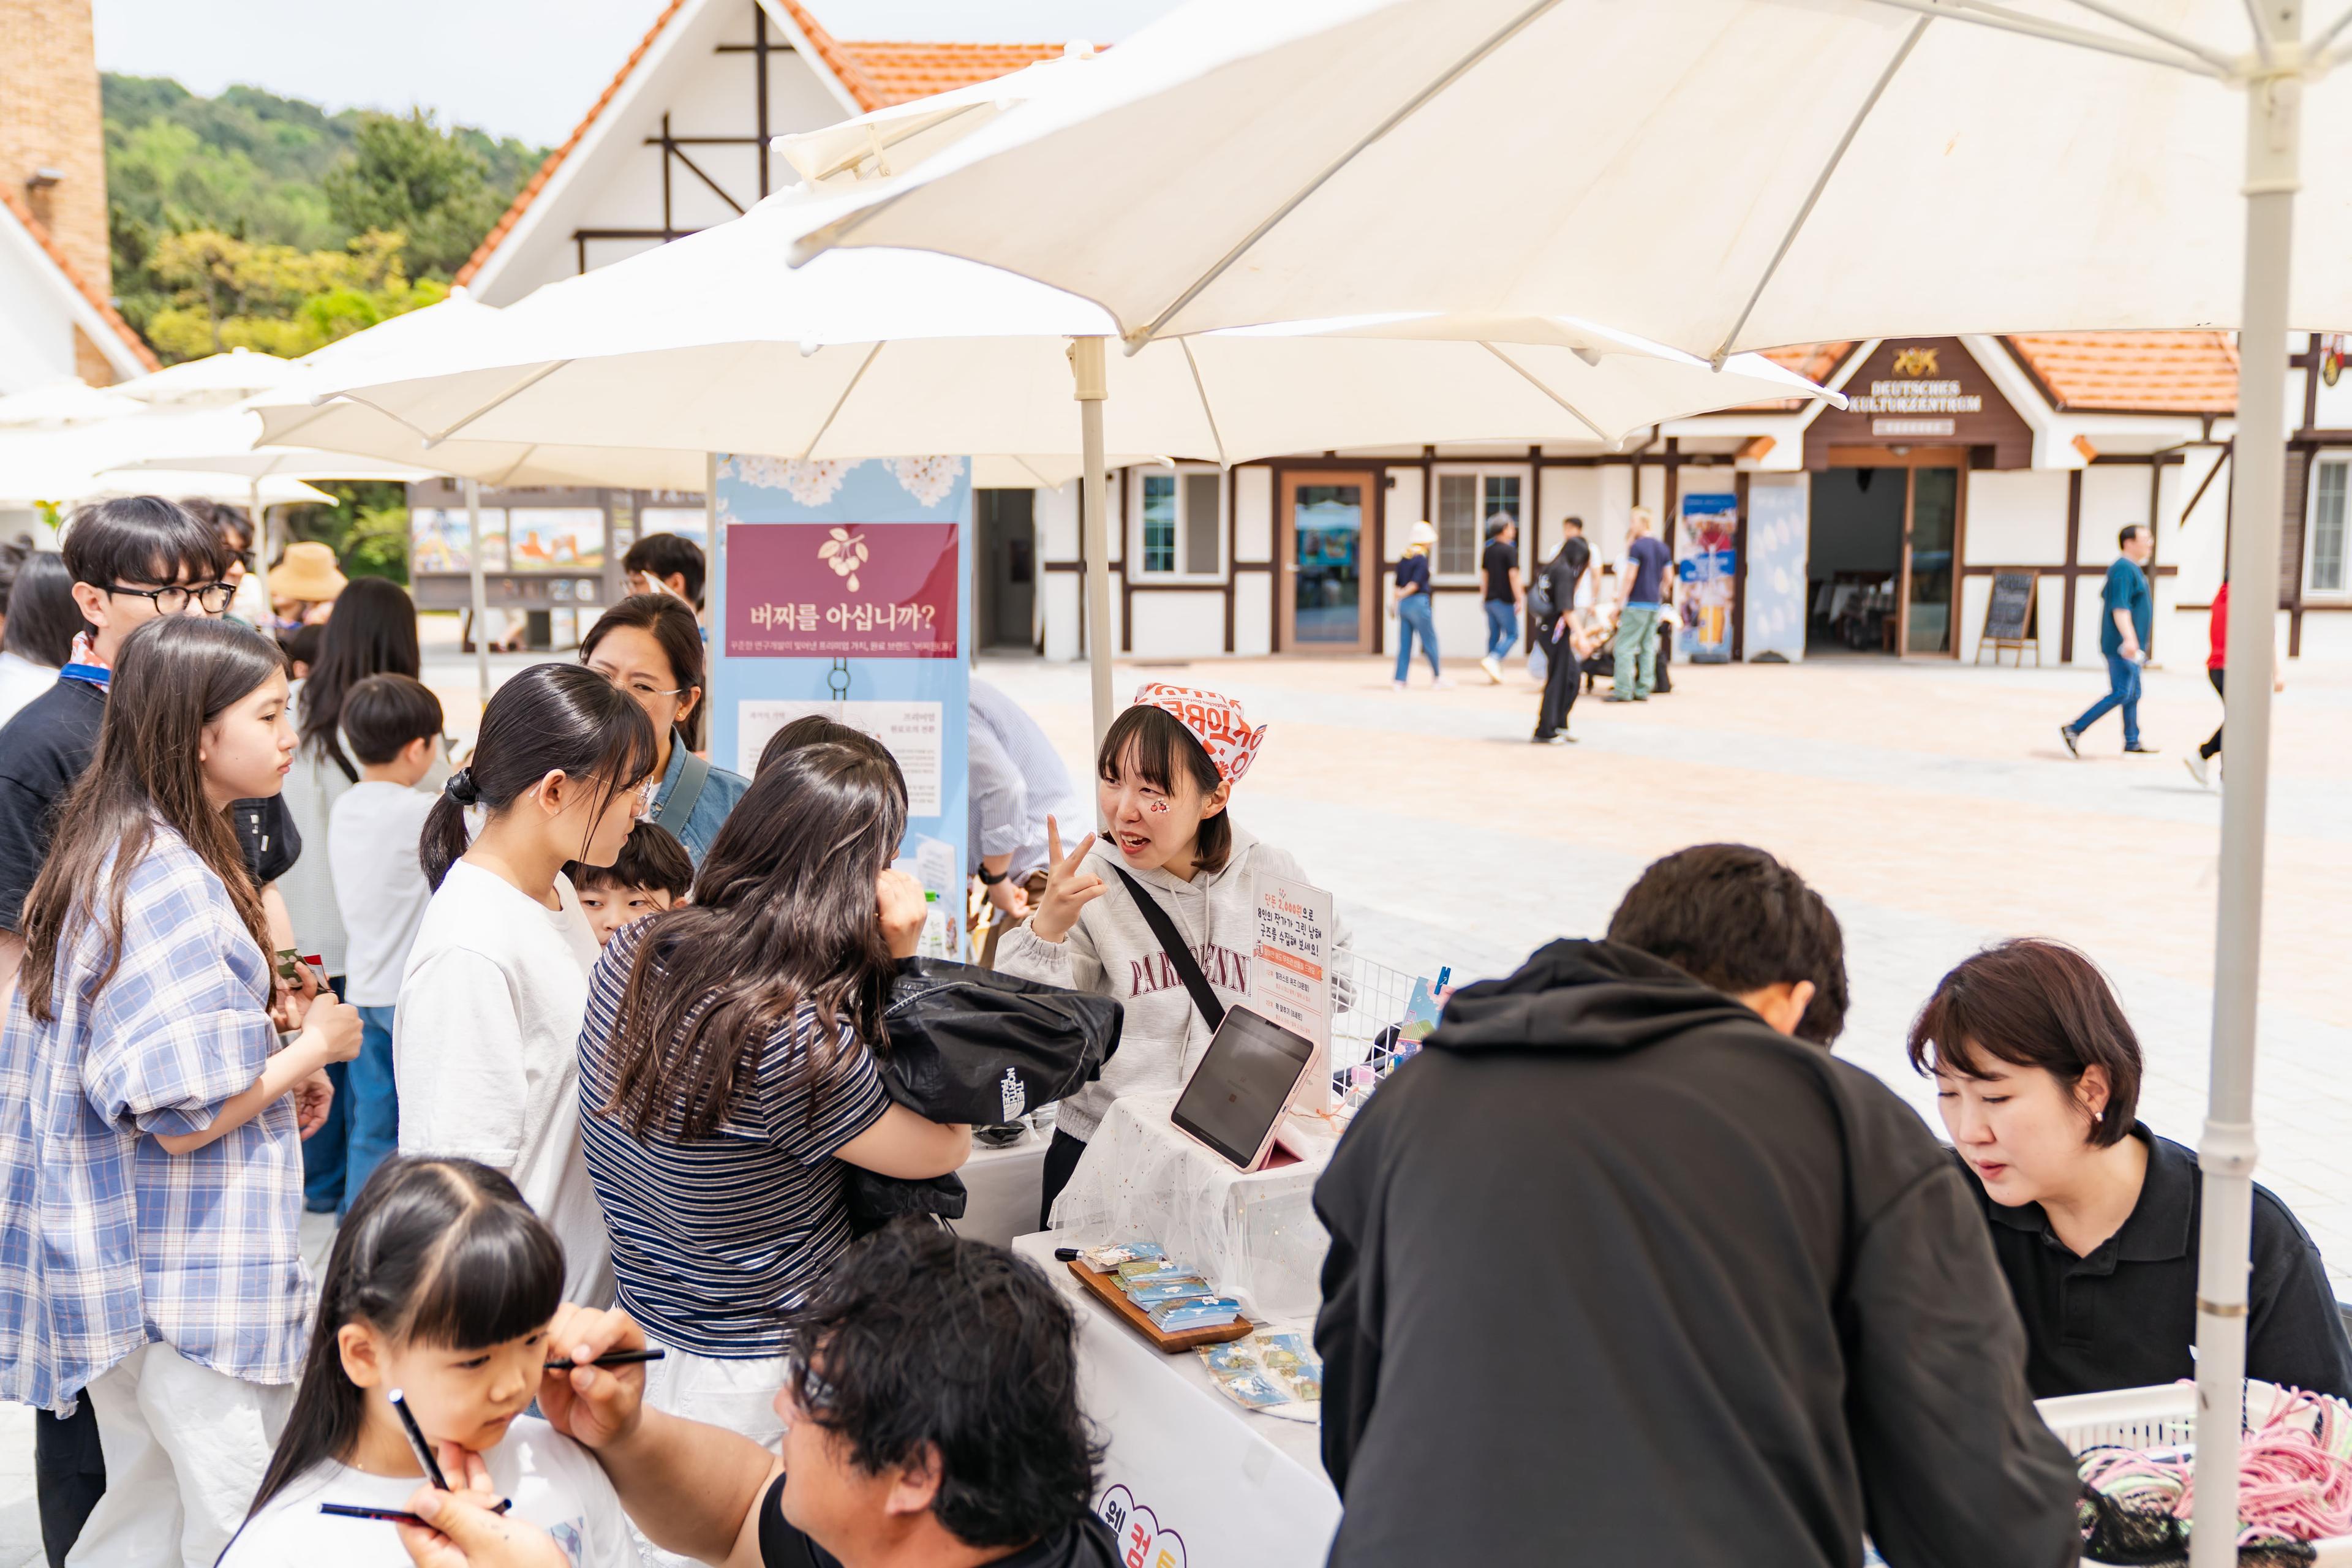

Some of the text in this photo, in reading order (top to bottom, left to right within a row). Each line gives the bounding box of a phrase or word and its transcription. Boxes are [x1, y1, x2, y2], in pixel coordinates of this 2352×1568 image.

[1871, 380, 1961, 396] DEUTSCHES
[1849, 395, 1982, 413] KULTURZENTRUM
[750, 603, 936, 632] 버찌를 아십니까?
[1265, 893, 1314, 922] 단돈 2,000원으로
[1257, 907, 1322, 940] 8인의 작가가 그린 남해
[1261, 923, 1319, 957] 굿즈를 수집해 보세요!
[1001, 1079, 1009, 1105] FACE
[1006, 1067, 1017, 1104] NORTH
[1016, 1080, 1025, 1102] THE
